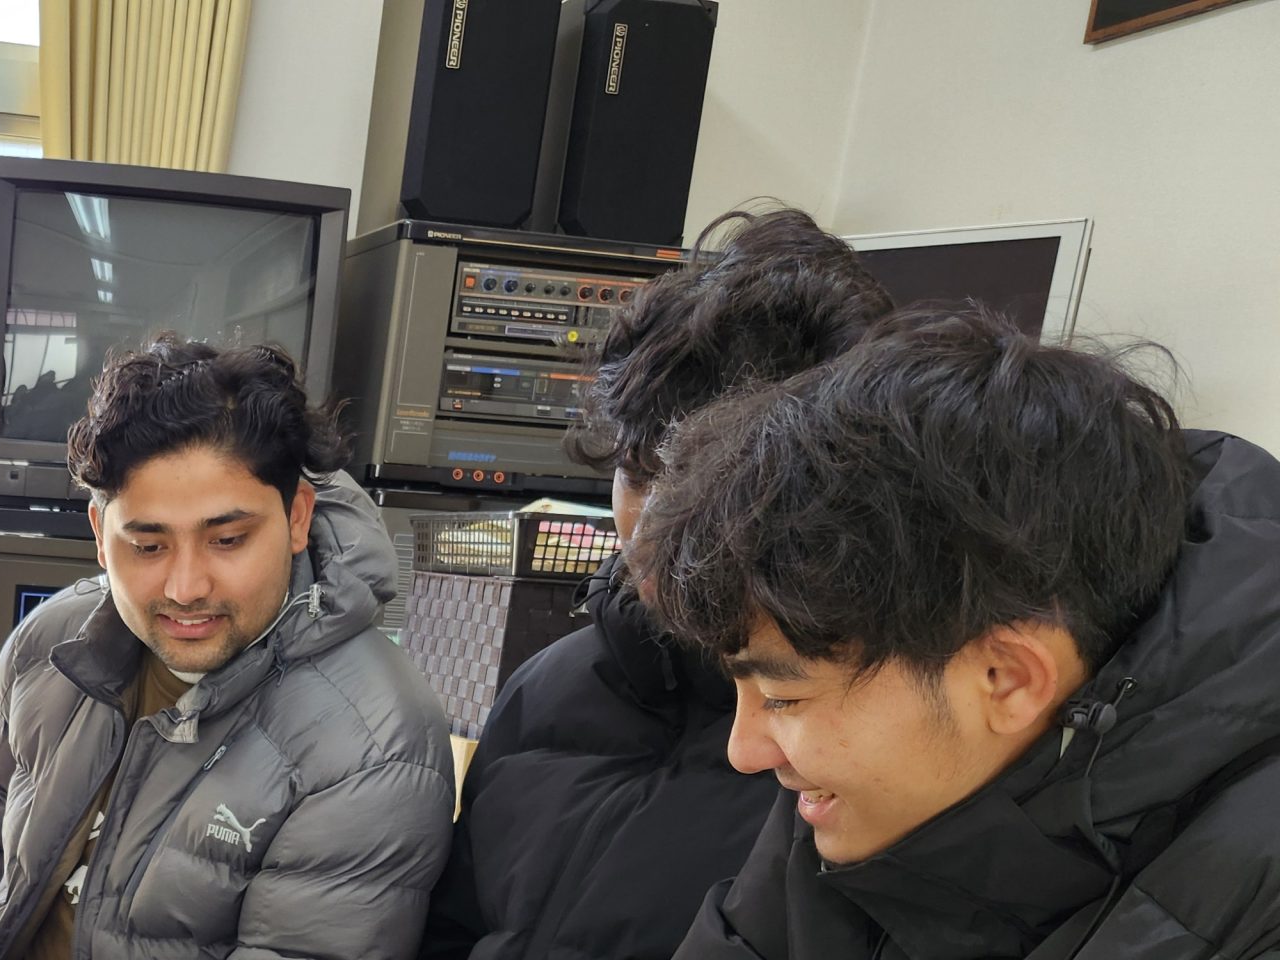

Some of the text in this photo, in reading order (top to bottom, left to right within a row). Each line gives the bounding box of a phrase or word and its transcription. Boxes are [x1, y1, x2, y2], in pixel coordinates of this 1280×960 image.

[448, 10, 464, 67] PIONEER
[608, 37, 625, 92] PIONEER
[206, 823, 240, 845] PUMA
